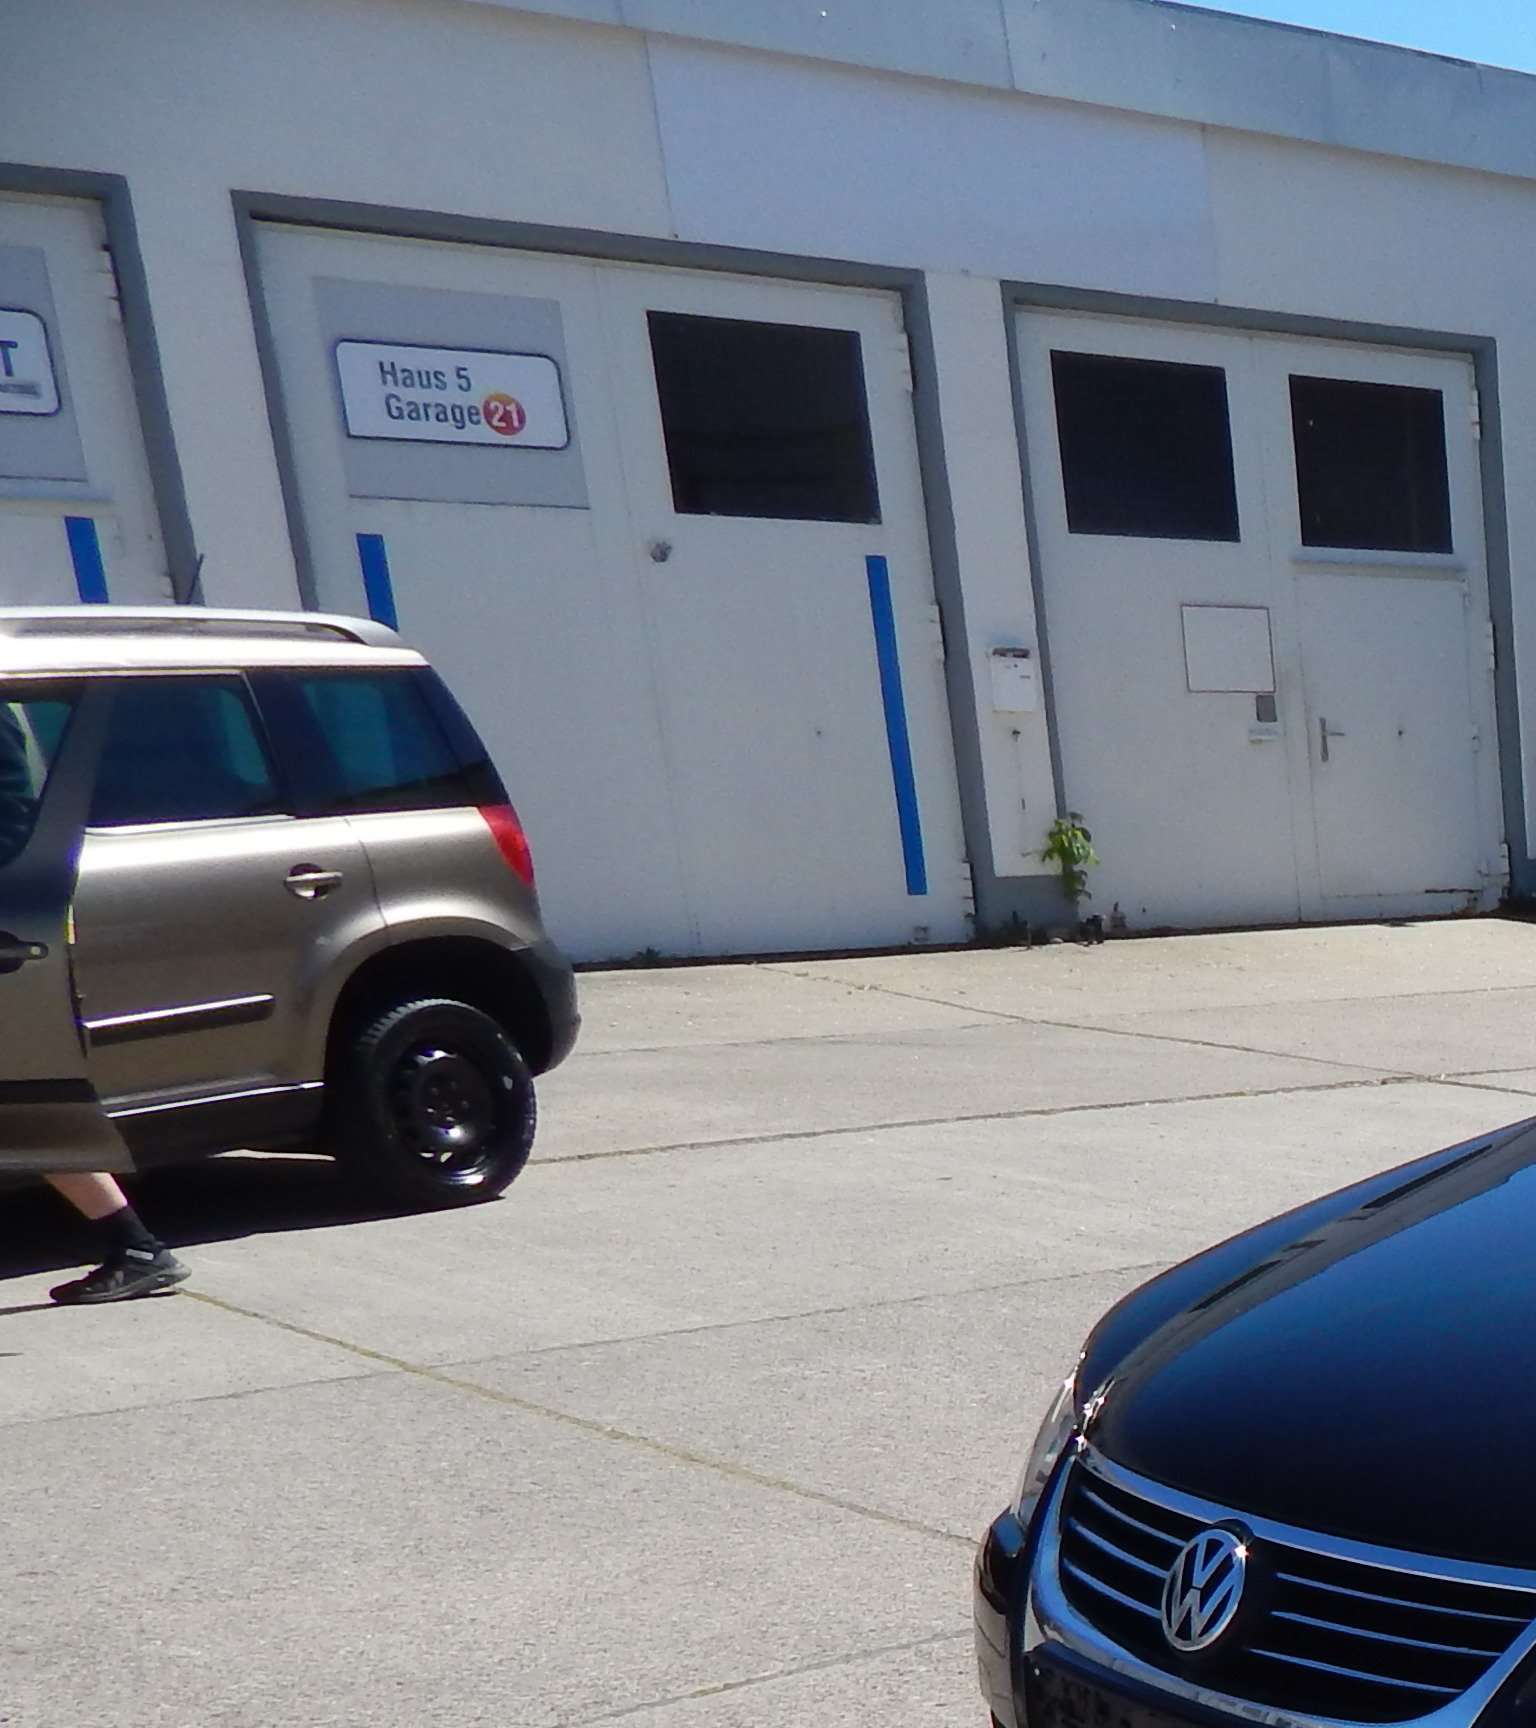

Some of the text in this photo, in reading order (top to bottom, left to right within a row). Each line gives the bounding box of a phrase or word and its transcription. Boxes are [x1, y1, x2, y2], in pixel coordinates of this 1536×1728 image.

[378, 360, 472, 392] Haus 5
[385, 393, 521, 430] Garage 21
[1161, 1528, 1246, 1651] VW
